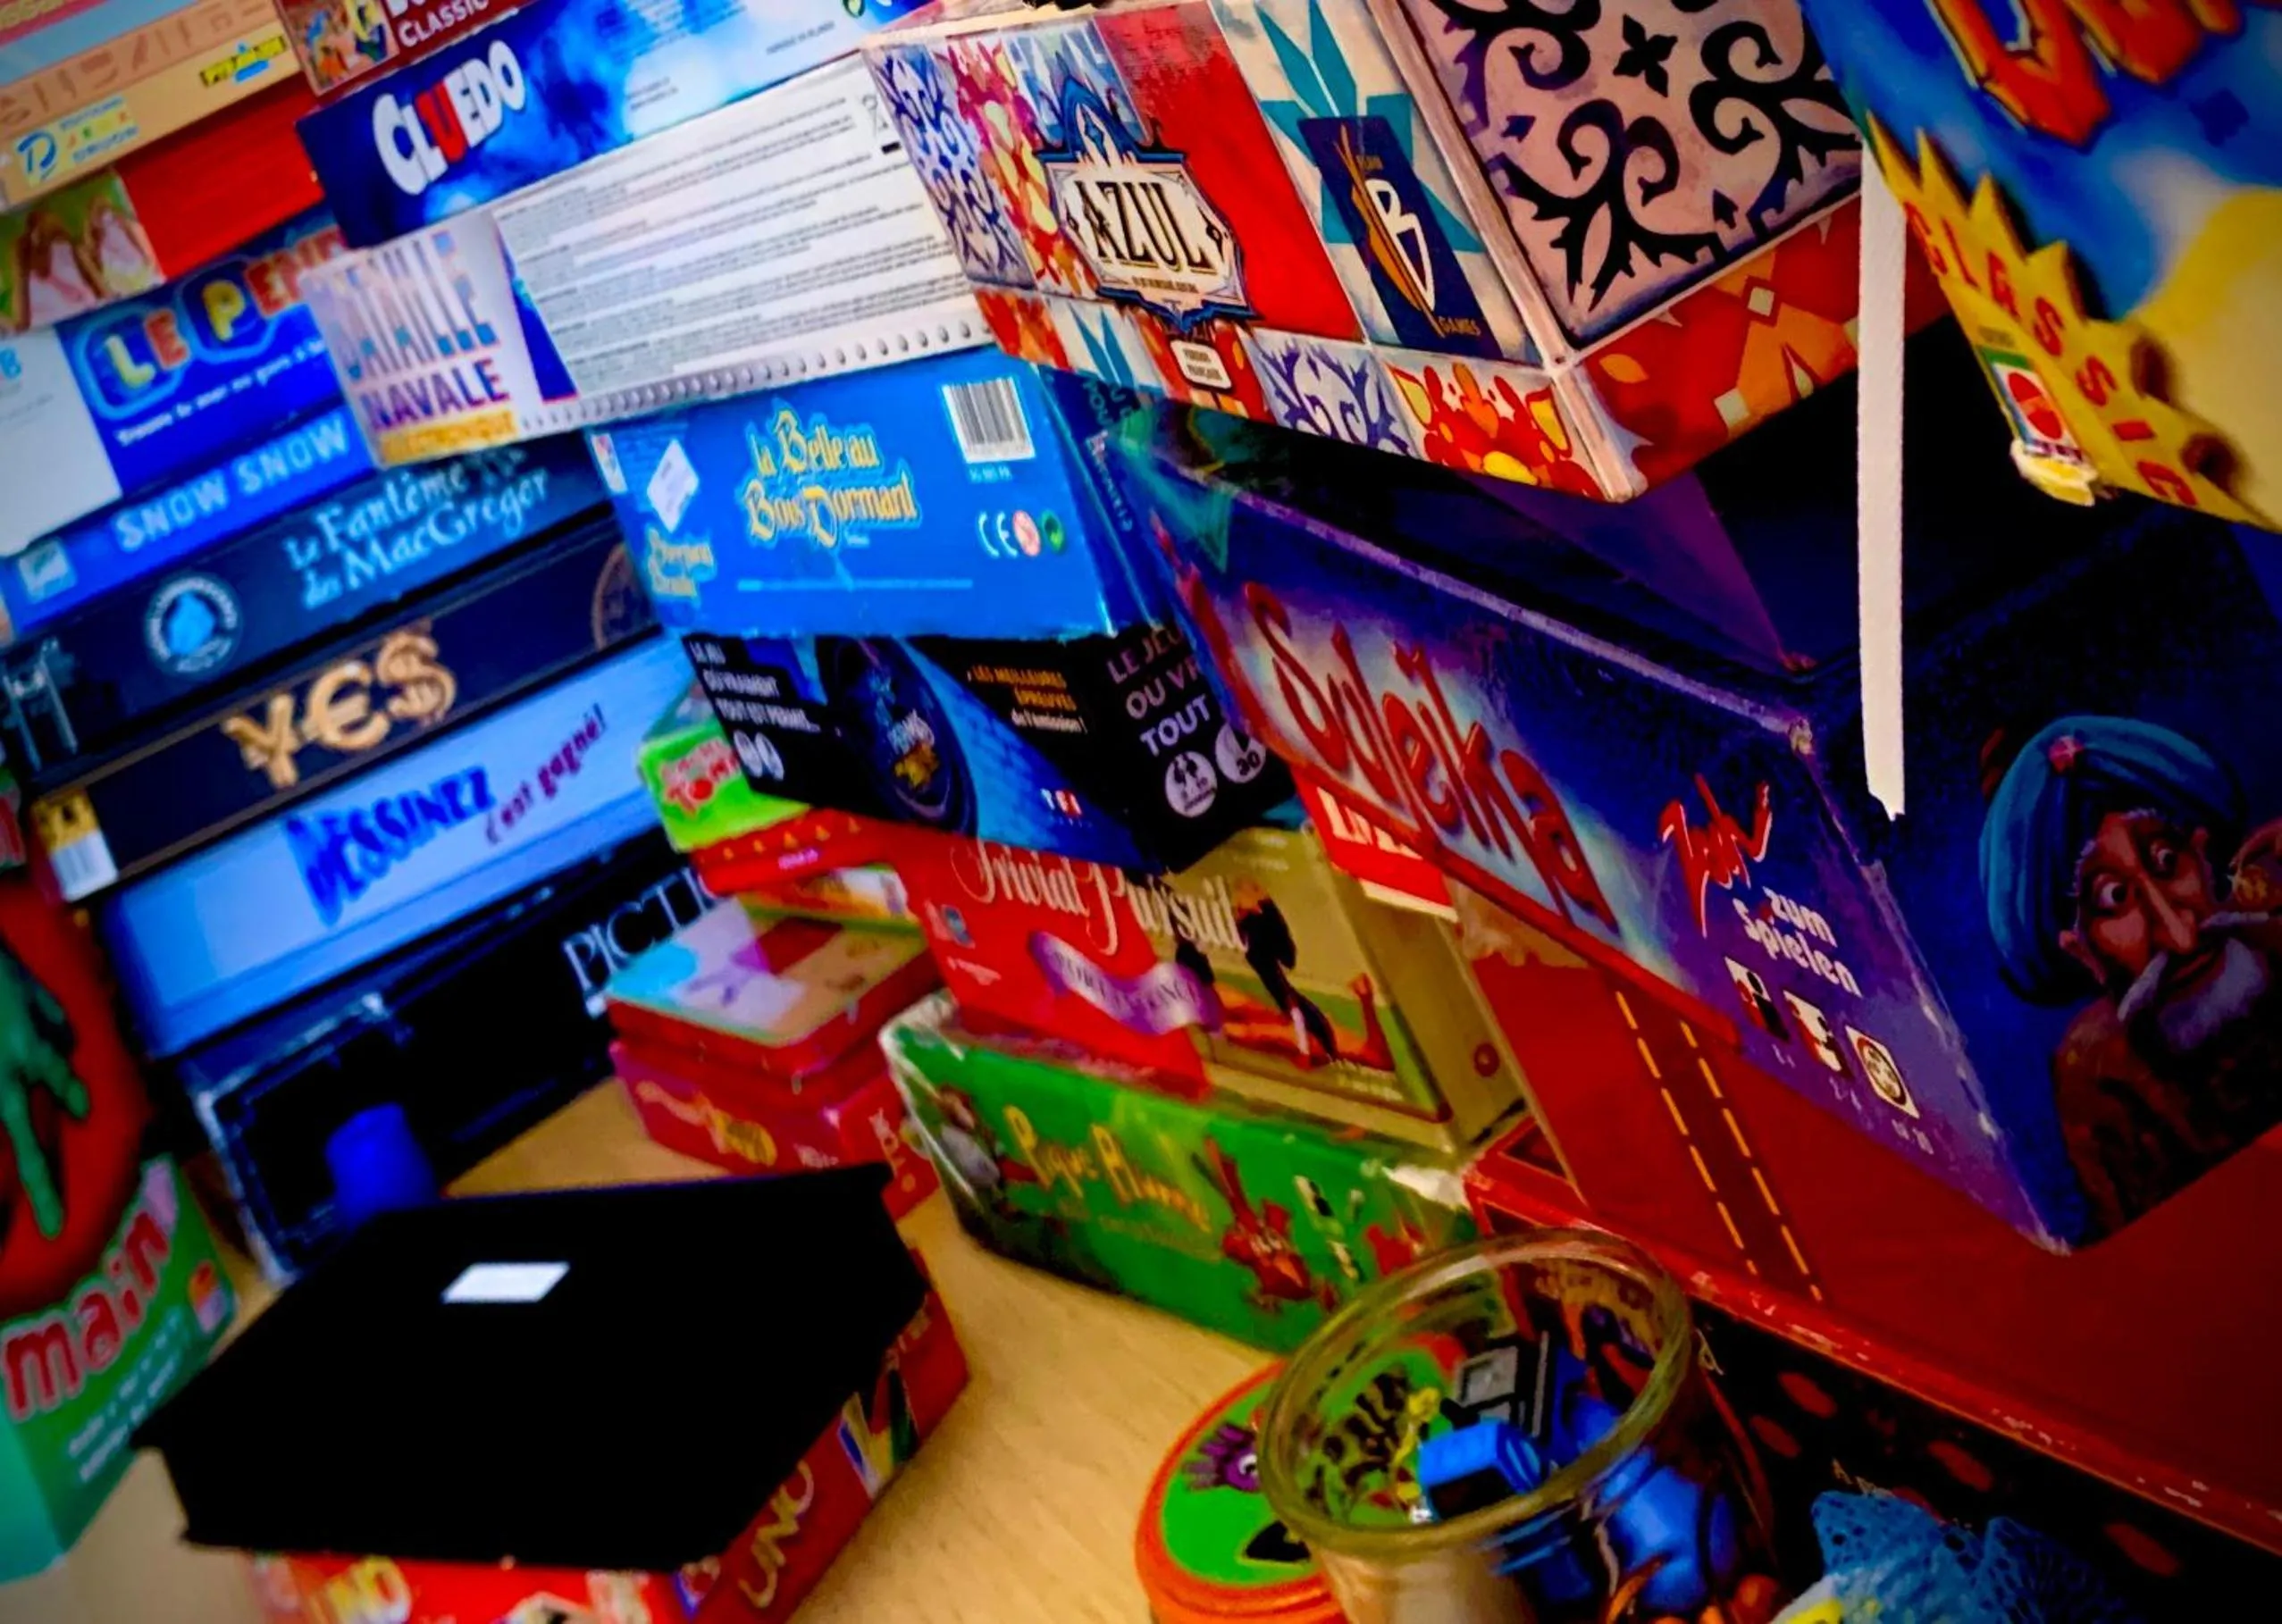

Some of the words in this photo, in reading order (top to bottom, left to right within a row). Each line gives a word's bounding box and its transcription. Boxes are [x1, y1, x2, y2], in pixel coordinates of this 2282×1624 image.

[398, 0, 489, 46] CLASSIC
[373, 40, 525, 195] CLUEDO
[1072, 180, 1220, 274] AZUL
[360, 359, 510, 432] NAVALE
[113, 467, 229, 555] SNOW
[234, 408, 350, 497] SNOW
[343, 468, 550, 590] MacGregor
[1107, 649, 1140, 685] LE
[1139, 694, 1211, 758] TOUT
[561, 865, 719, 993] PICTI
[949, 840, 1092, 918] Trivial
[1075, 859, 1250, 956] Pursuit
[1732, 897, 1864, 999] Spielen
[1762, 885, 1839, 948] zum
[2, 1211, 172, 1422] main
